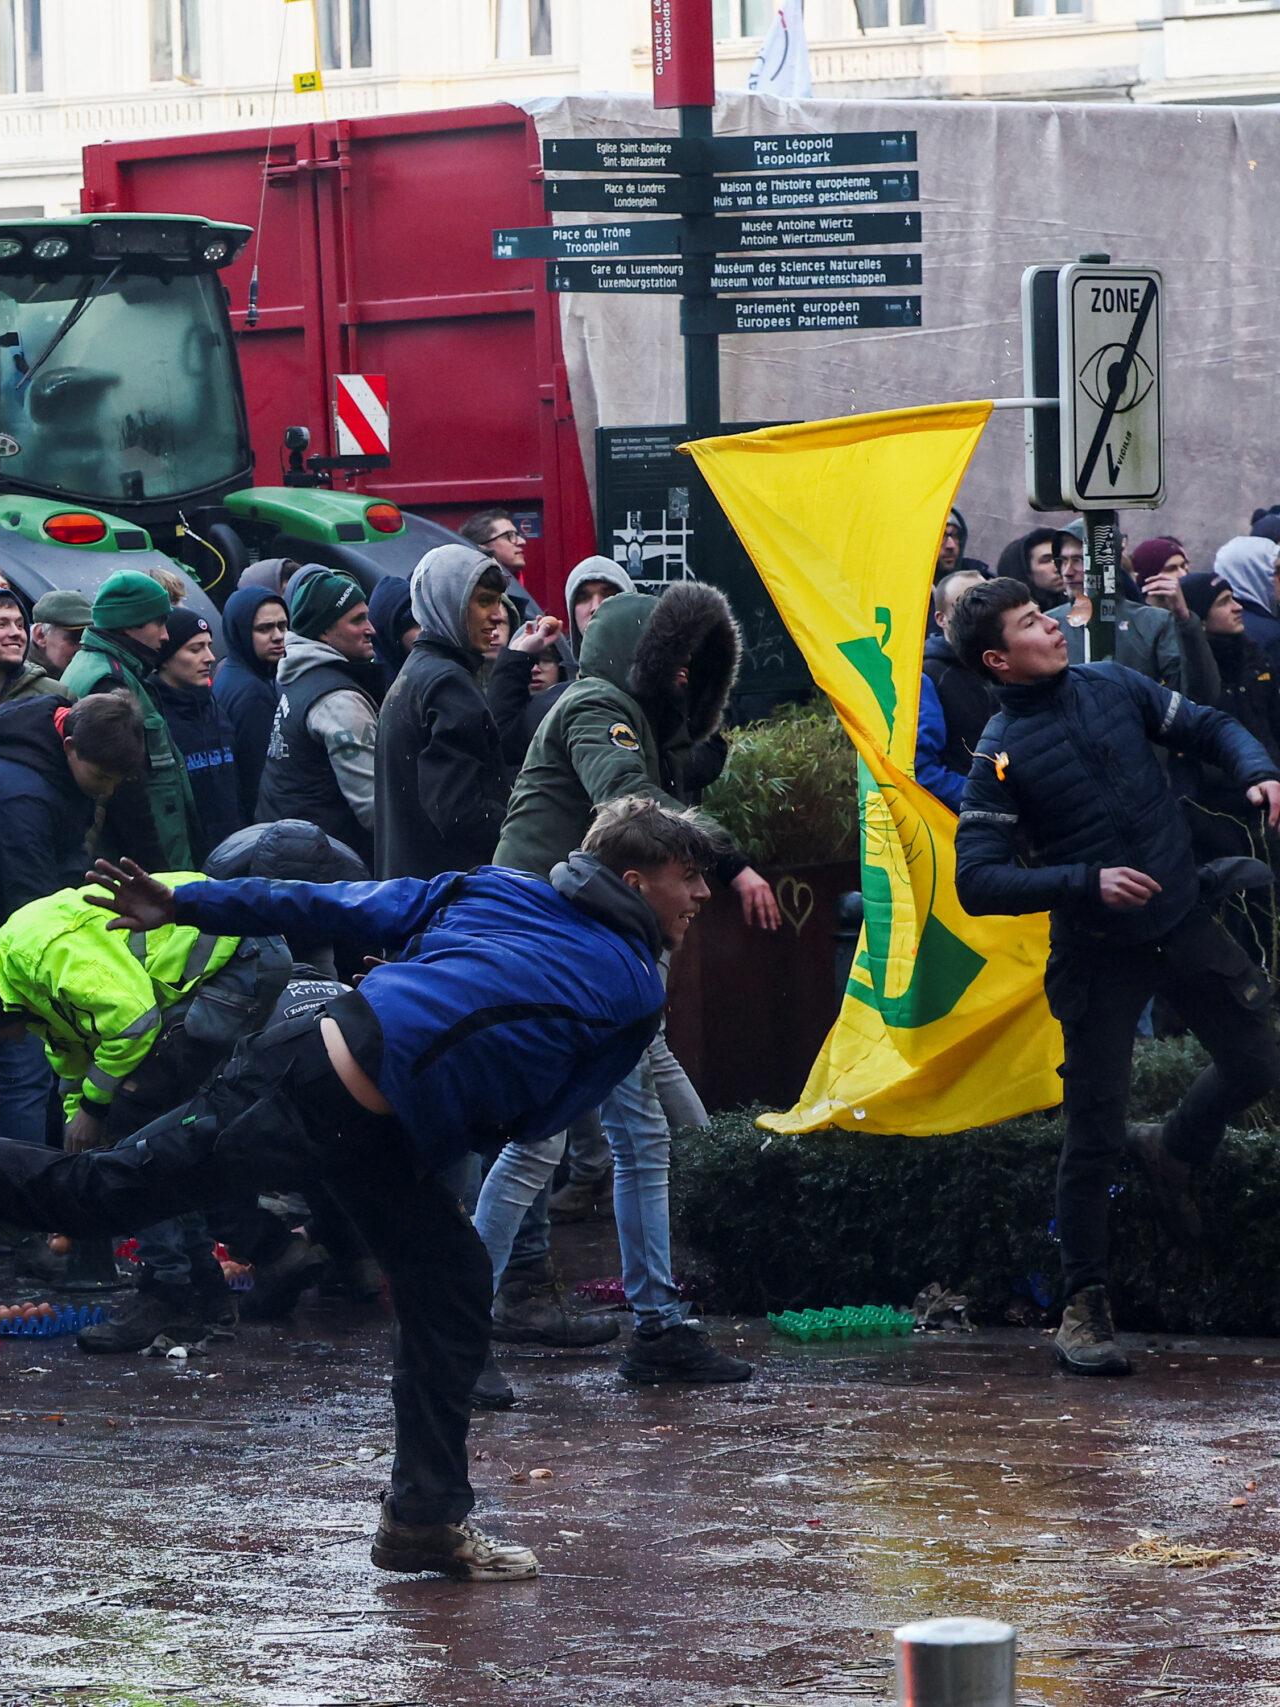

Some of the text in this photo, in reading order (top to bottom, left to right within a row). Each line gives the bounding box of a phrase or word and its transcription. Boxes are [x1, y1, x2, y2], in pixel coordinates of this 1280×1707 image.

[654, 0, 664, 76] Quartier Lé
[663, 0, 672, 61] Léopolds
[596, 142, 672, 154] Eglise Saint-Boniface
[754, 137, 833, 152] Parc Léopold
[603, 156, 666, 167] Sint-Bonifaaskerk
[756, 151, 831, 166] Leopoldpark
[604, 183, 666, 194] Place de Londres
[720, 176, 871, 193] Maison de l'histoire européenne
[613, 197, 658, 208] Londenplein
[713, 188, 879, 207] Huis van de Europese geschiedenis
[741, 217, 854, 232] Musée Antoine Wiertz
[552, 226, 631, 241] Place du Trône
[740, 231, 856, 246] Antoine Wiertzmuseum
[565, 241, 619, 254] Troonplein
[590, 264, 684, 277] Gare du Luxembourg
[713, 257, 882, 274] Muséum des Sciences Naturelles
[598, 277, 678, 290] Luxemburgstation
[710, 271, 887, 288] Museum voor Natuurwetenschappen
[735, 300, 861, 315] Parlement européen
[1091, 287, 1140, 313] ZONE
[736, 313, 859, 329] Europees Parlement
[1116, 430, 1132, 466] VIGILIS
[290, 985, 338, 998] Kring
